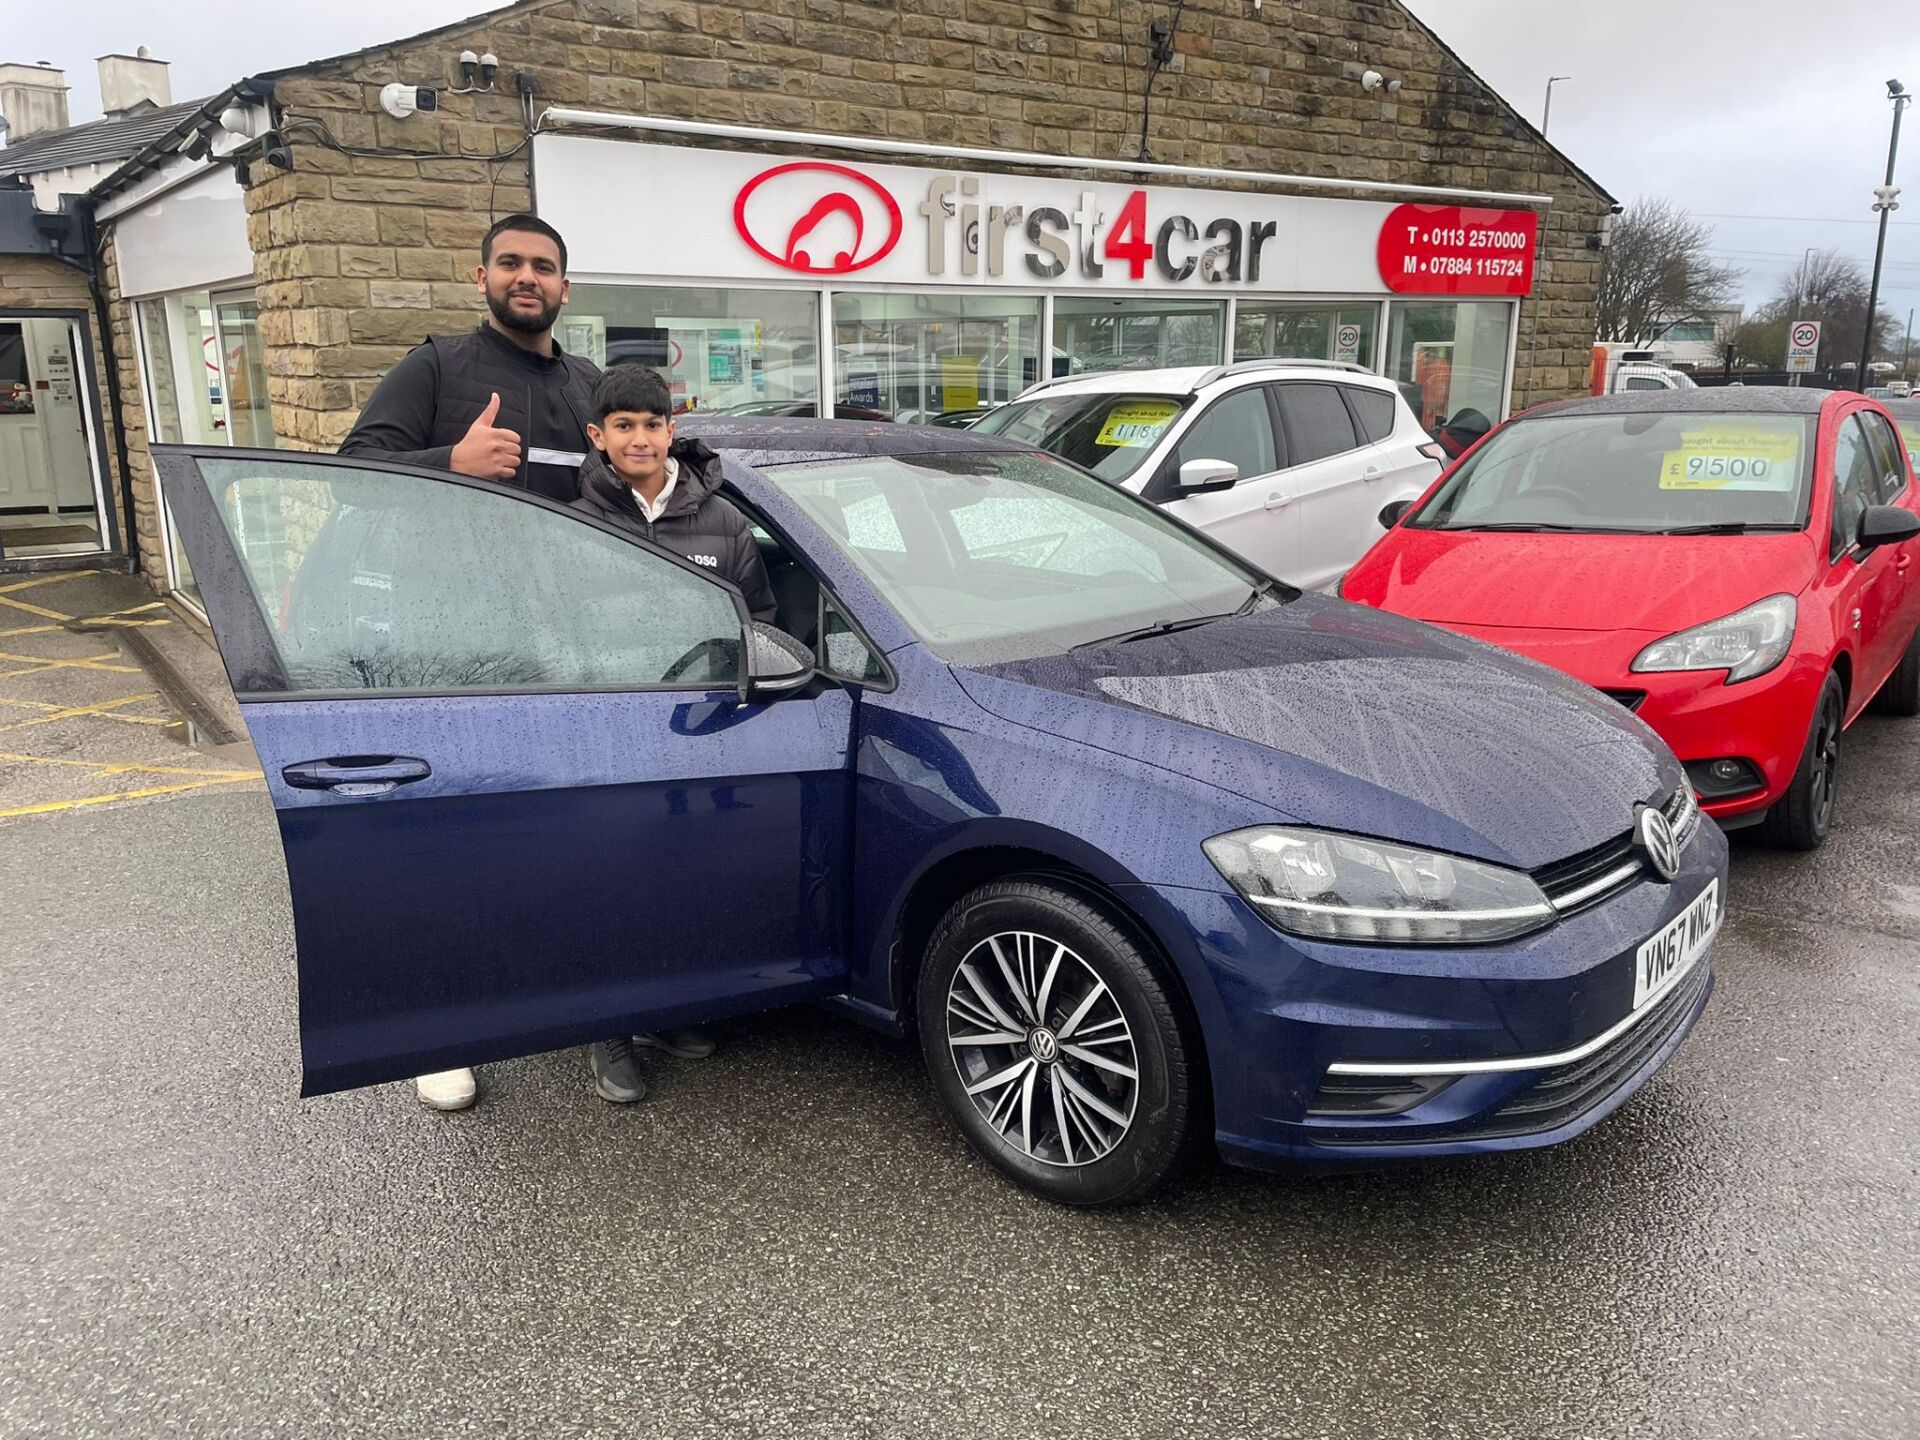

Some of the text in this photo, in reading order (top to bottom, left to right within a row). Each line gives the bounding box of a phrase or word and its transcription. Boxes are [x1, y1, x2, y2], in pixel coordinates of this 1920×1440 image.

[920, 176, 1277, 282] first4car
[1407, 226, 1526, 249] T 0113 2570000
[1403, 256, 1523, 276] M 07884 115724
[1342, 332, 1355, 341] 20
[1797, 330, 1814, 340] 20
[849, 392, 874, 403] Awards
[1104, 427, 1114, 436] £
[1669, 457, 1768, 477] £ 9500
[1646, 917, 1687, 991] VN67
